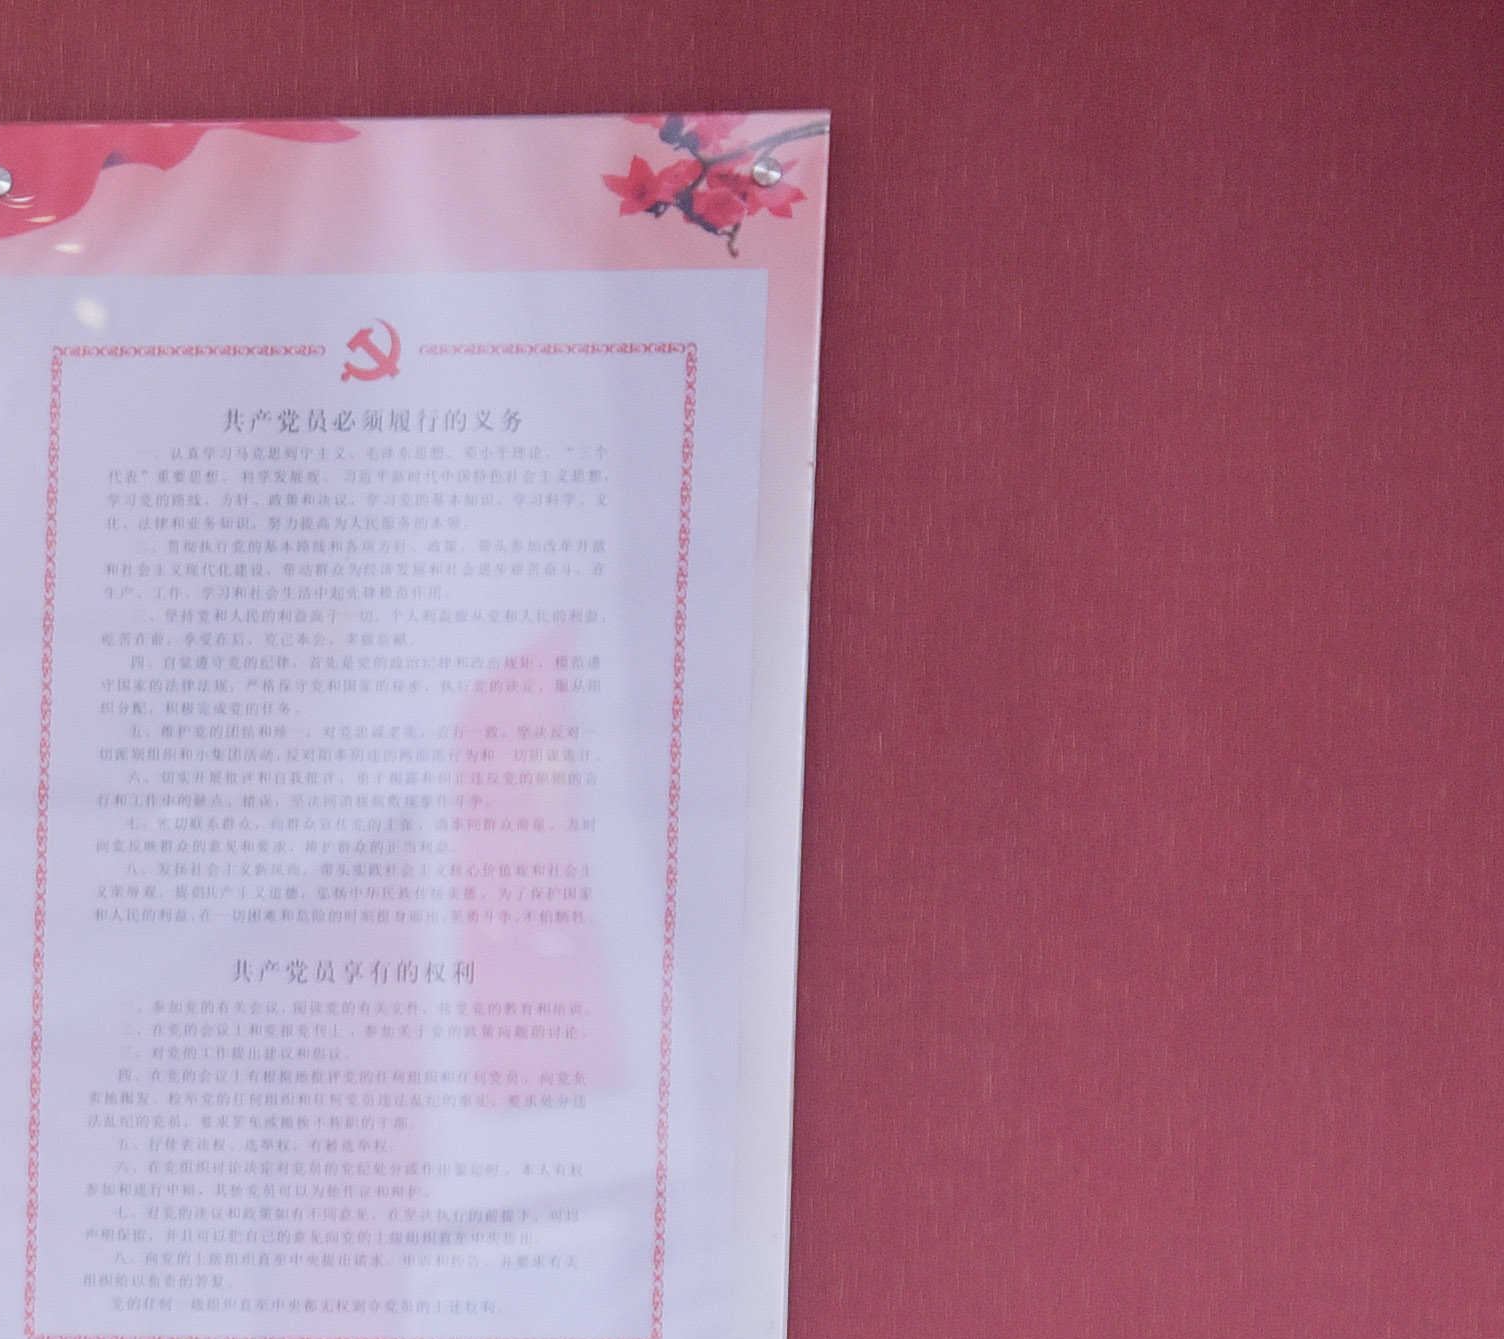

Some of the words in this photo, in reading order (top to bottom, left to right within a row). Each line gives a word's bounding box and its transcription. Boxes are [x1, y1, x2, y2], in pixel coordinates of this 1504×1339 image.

[222, 406, 525, 435] 共产党员必须履行的义务
[231, 958, 476, 986] 共产党员享有的权利
